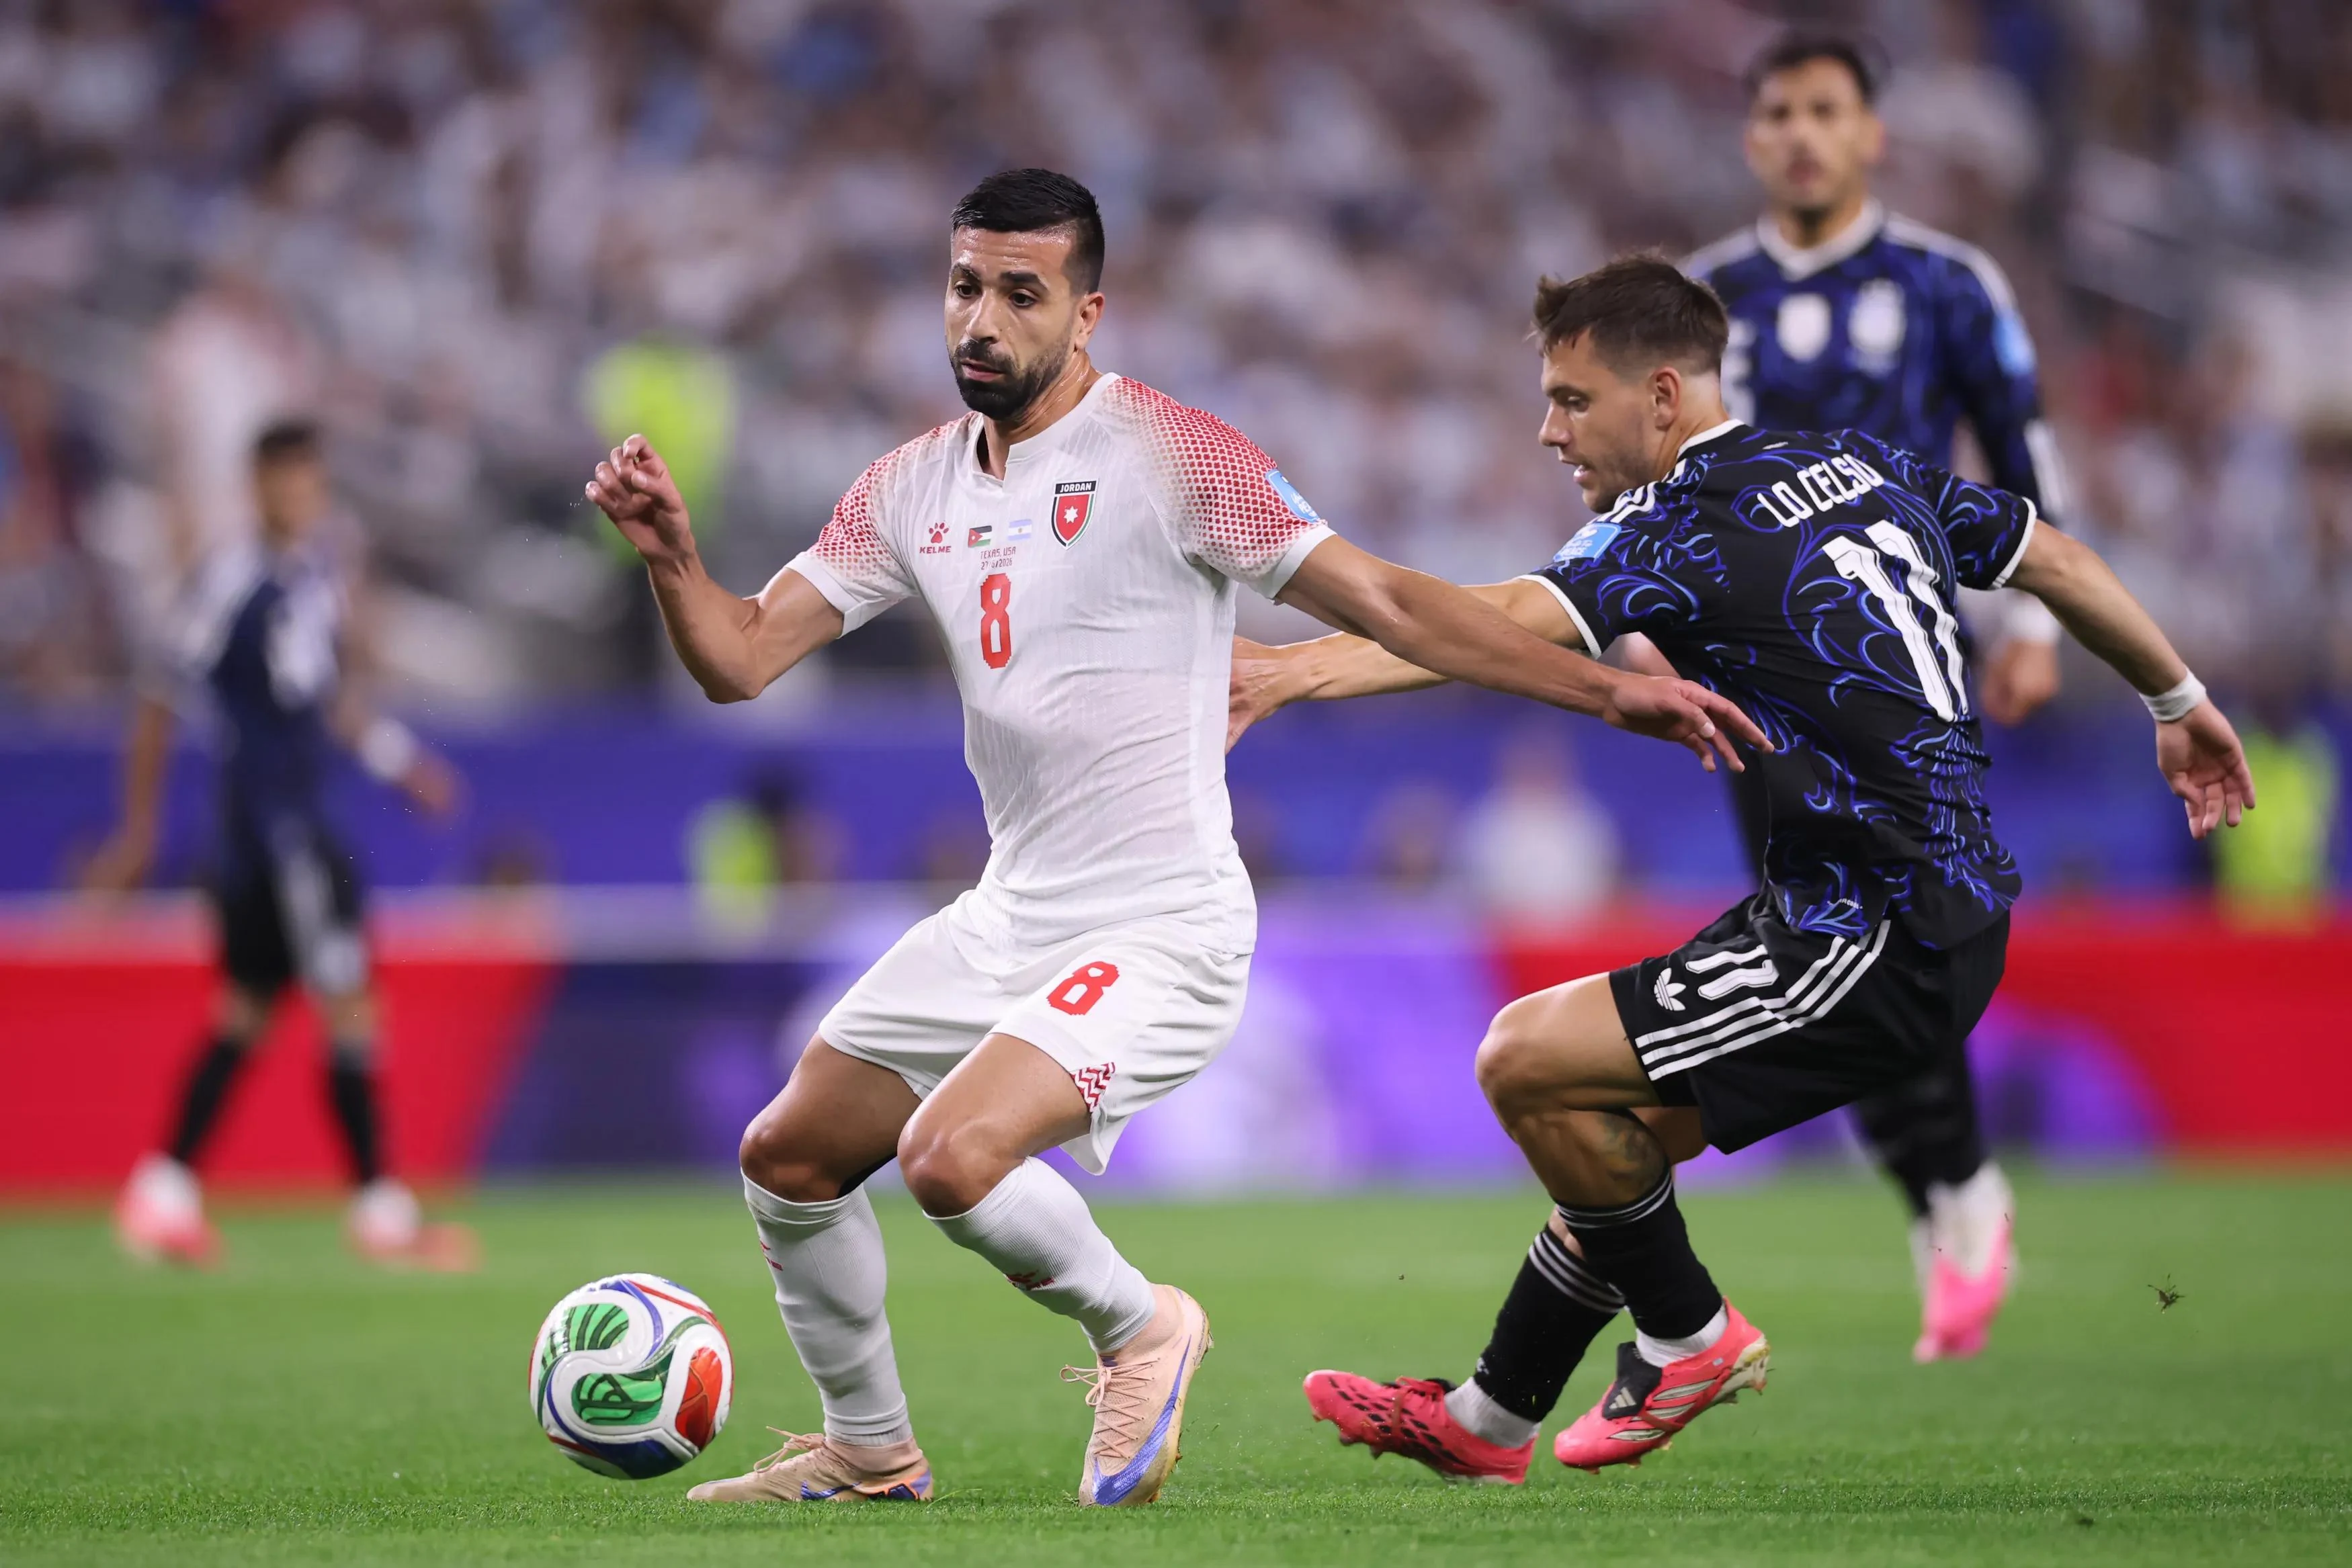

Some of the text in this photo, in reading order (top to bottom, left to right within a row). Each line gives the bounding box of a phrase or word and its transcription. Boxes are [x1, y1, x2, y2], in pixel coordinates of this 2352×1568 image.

[1060, 482, 1092, 493] JORDAN
[1757, 453, 1884, 527] LO CELSO
[919, 546, 952, 554] KELME
[981, 558, 1013, 570] 276/2026
[1003, 546, 1016, 556] USA
[980, 572, 1011, 669] 8
[1822, 519, 1968, 722] 11
[1046, 961, 1120, 1016] 8
